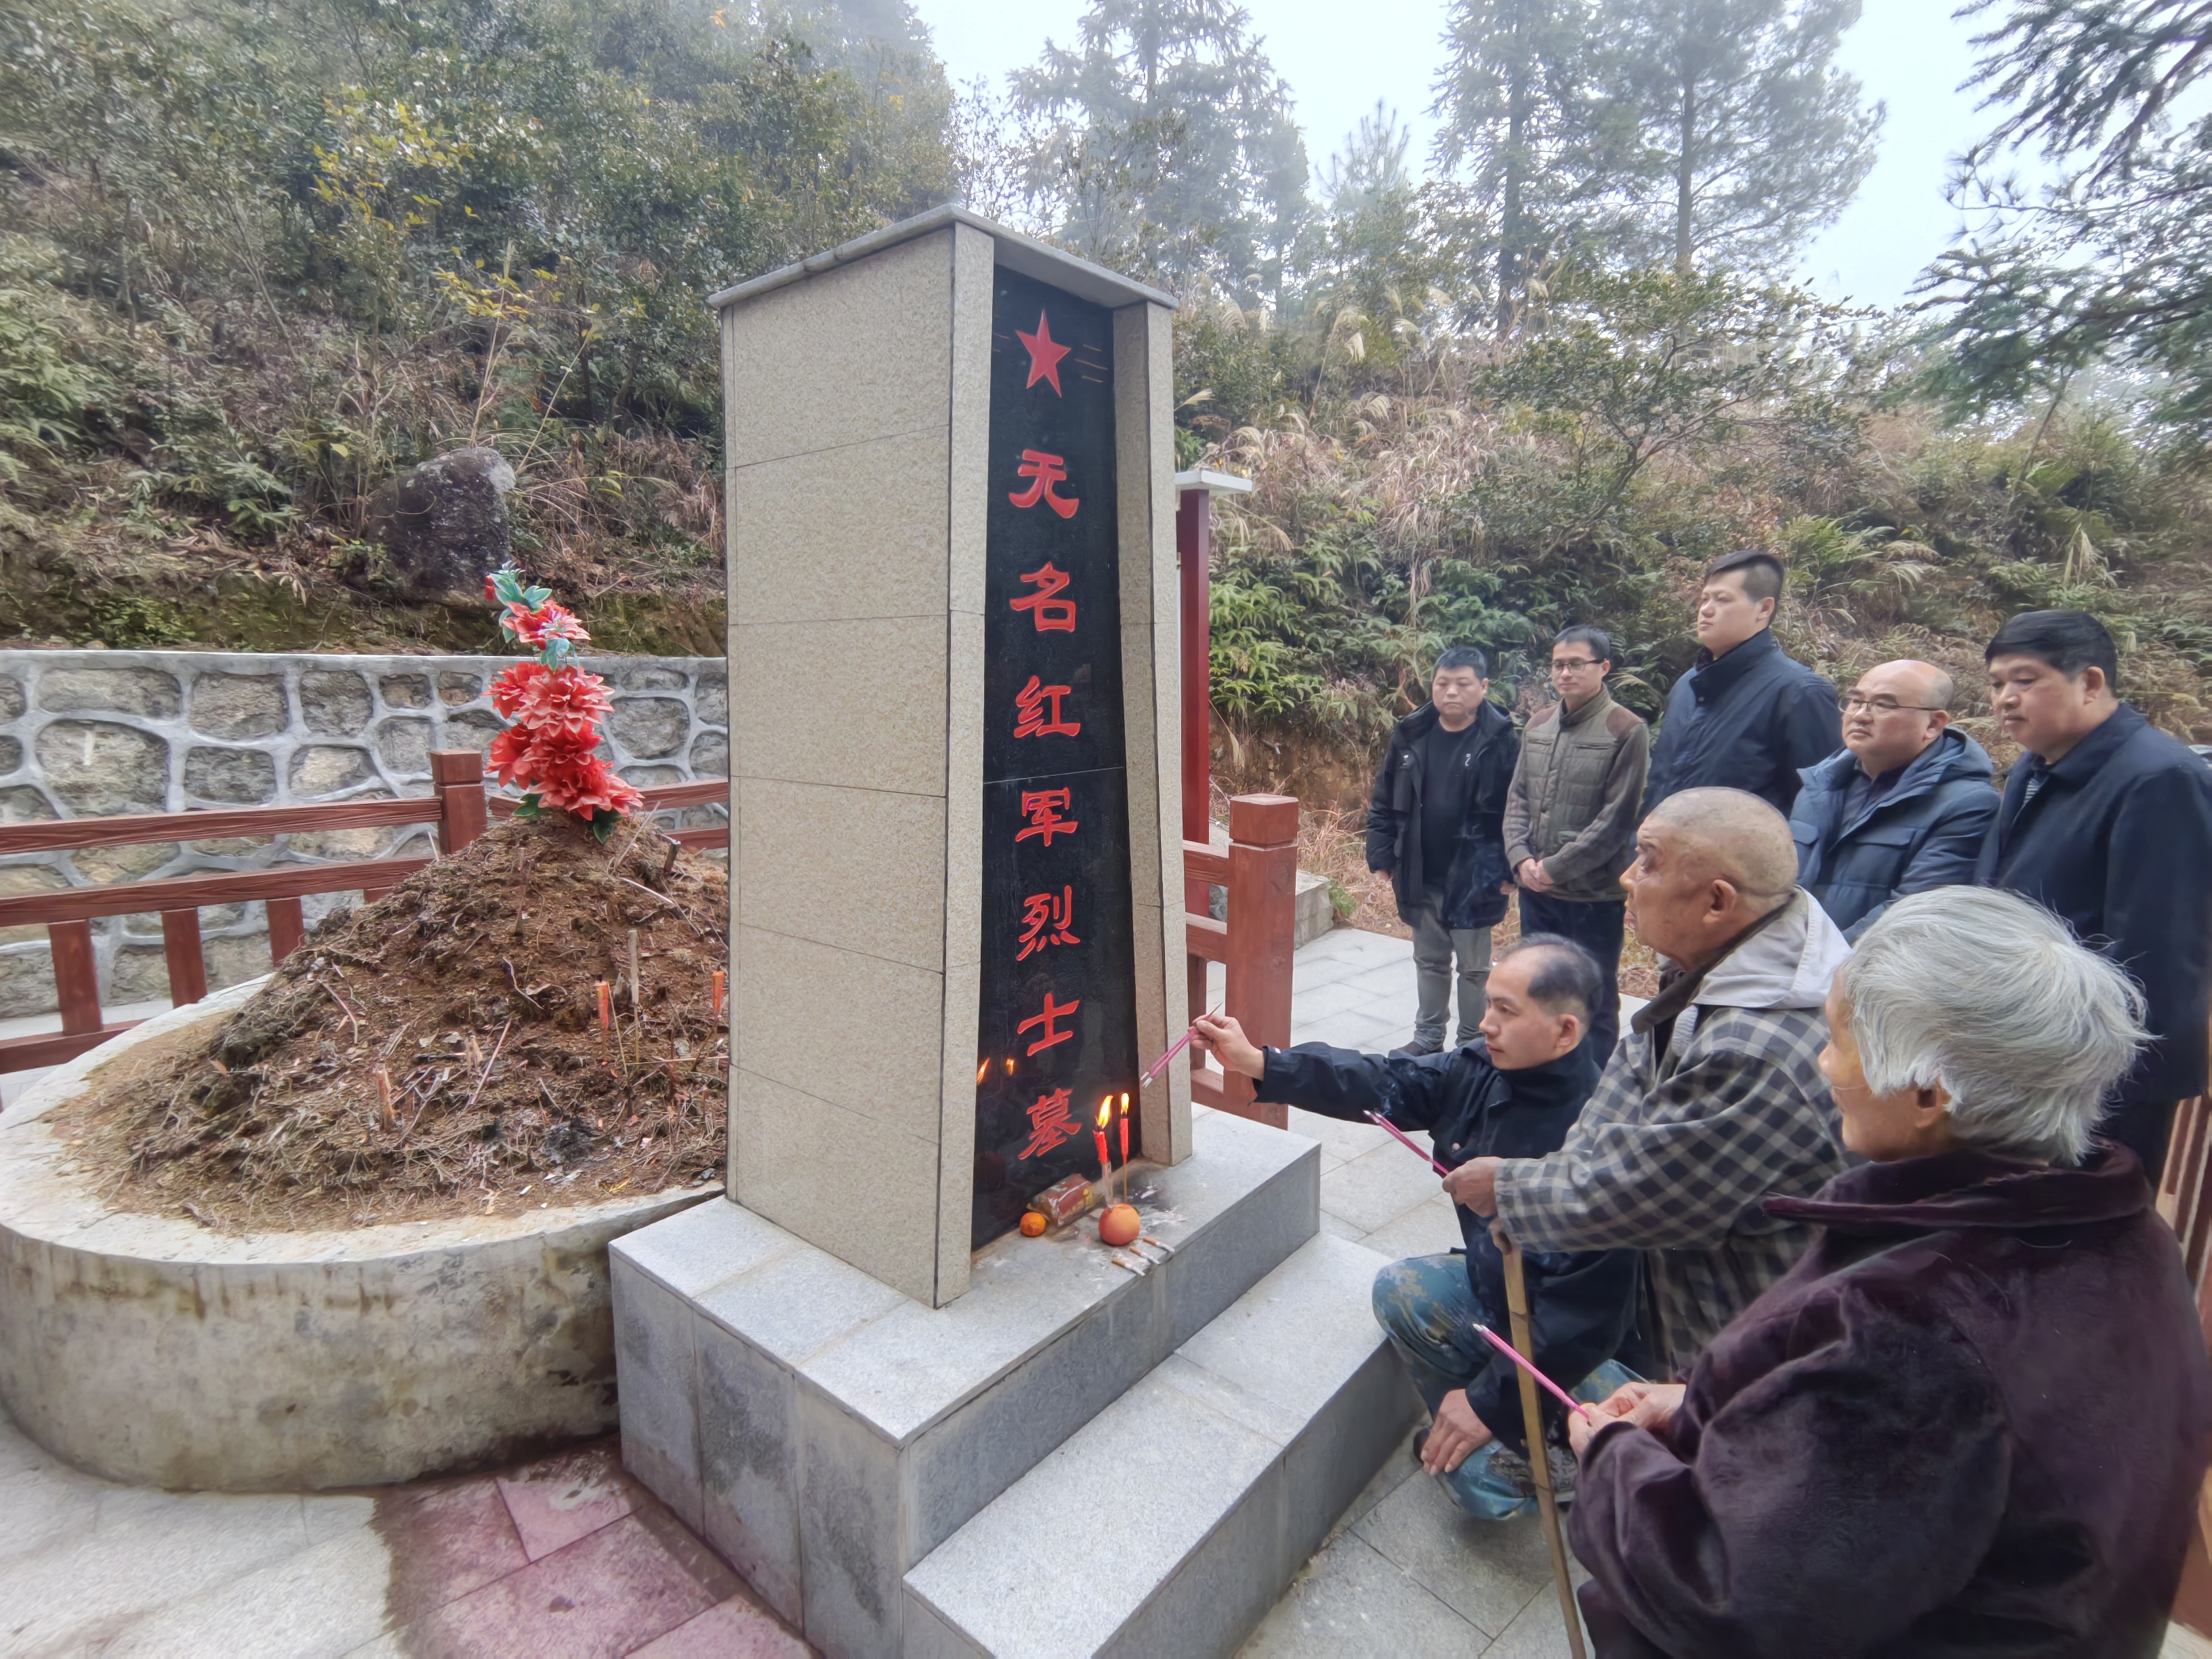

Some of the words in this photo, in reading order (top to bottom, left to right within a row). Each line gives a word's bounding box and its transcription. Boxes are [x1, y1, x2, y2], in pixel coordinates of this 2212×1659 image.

[1008, 448, 1082, 1160] 无名红军烈士墓
